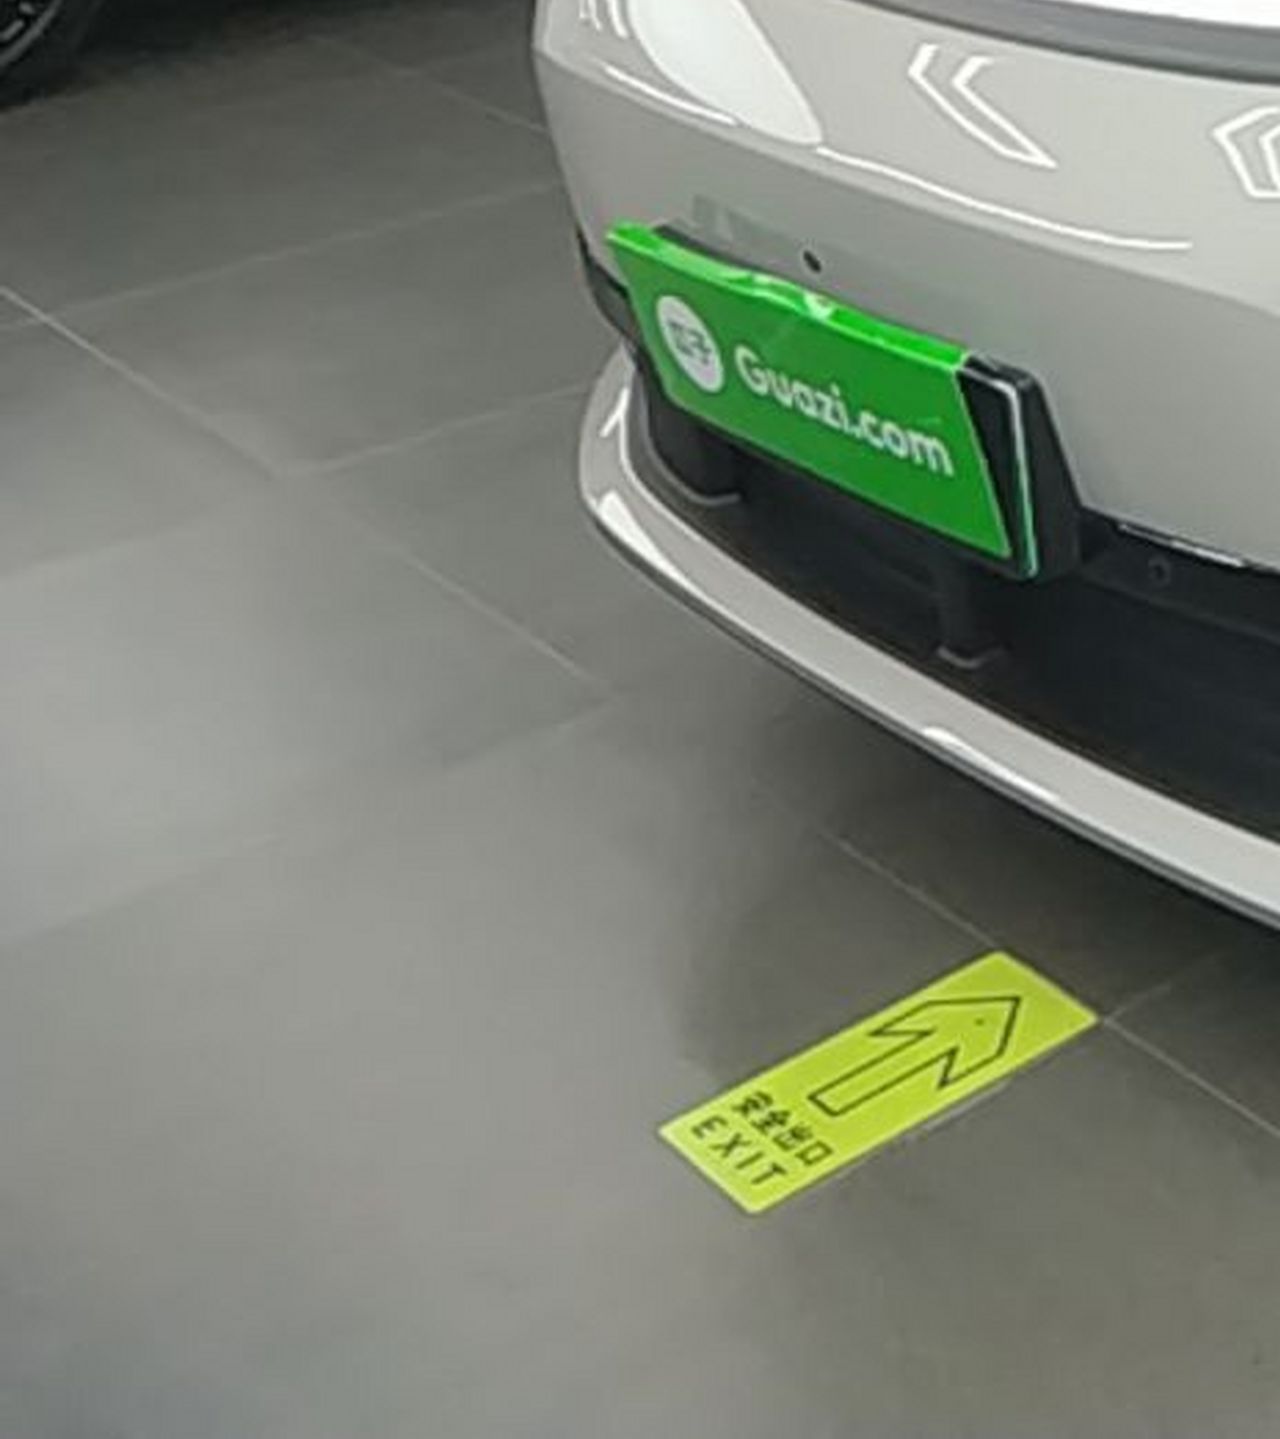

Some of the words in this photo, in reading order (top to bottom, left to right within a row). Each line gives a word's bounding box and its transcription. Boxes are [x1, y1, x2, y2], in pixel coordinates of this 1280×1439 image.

[735, 344, 954, 478] Guazi.com
[691, 1115, 788, 1185] EXIT
[732, 1091, 834, 1166] 安全出口
